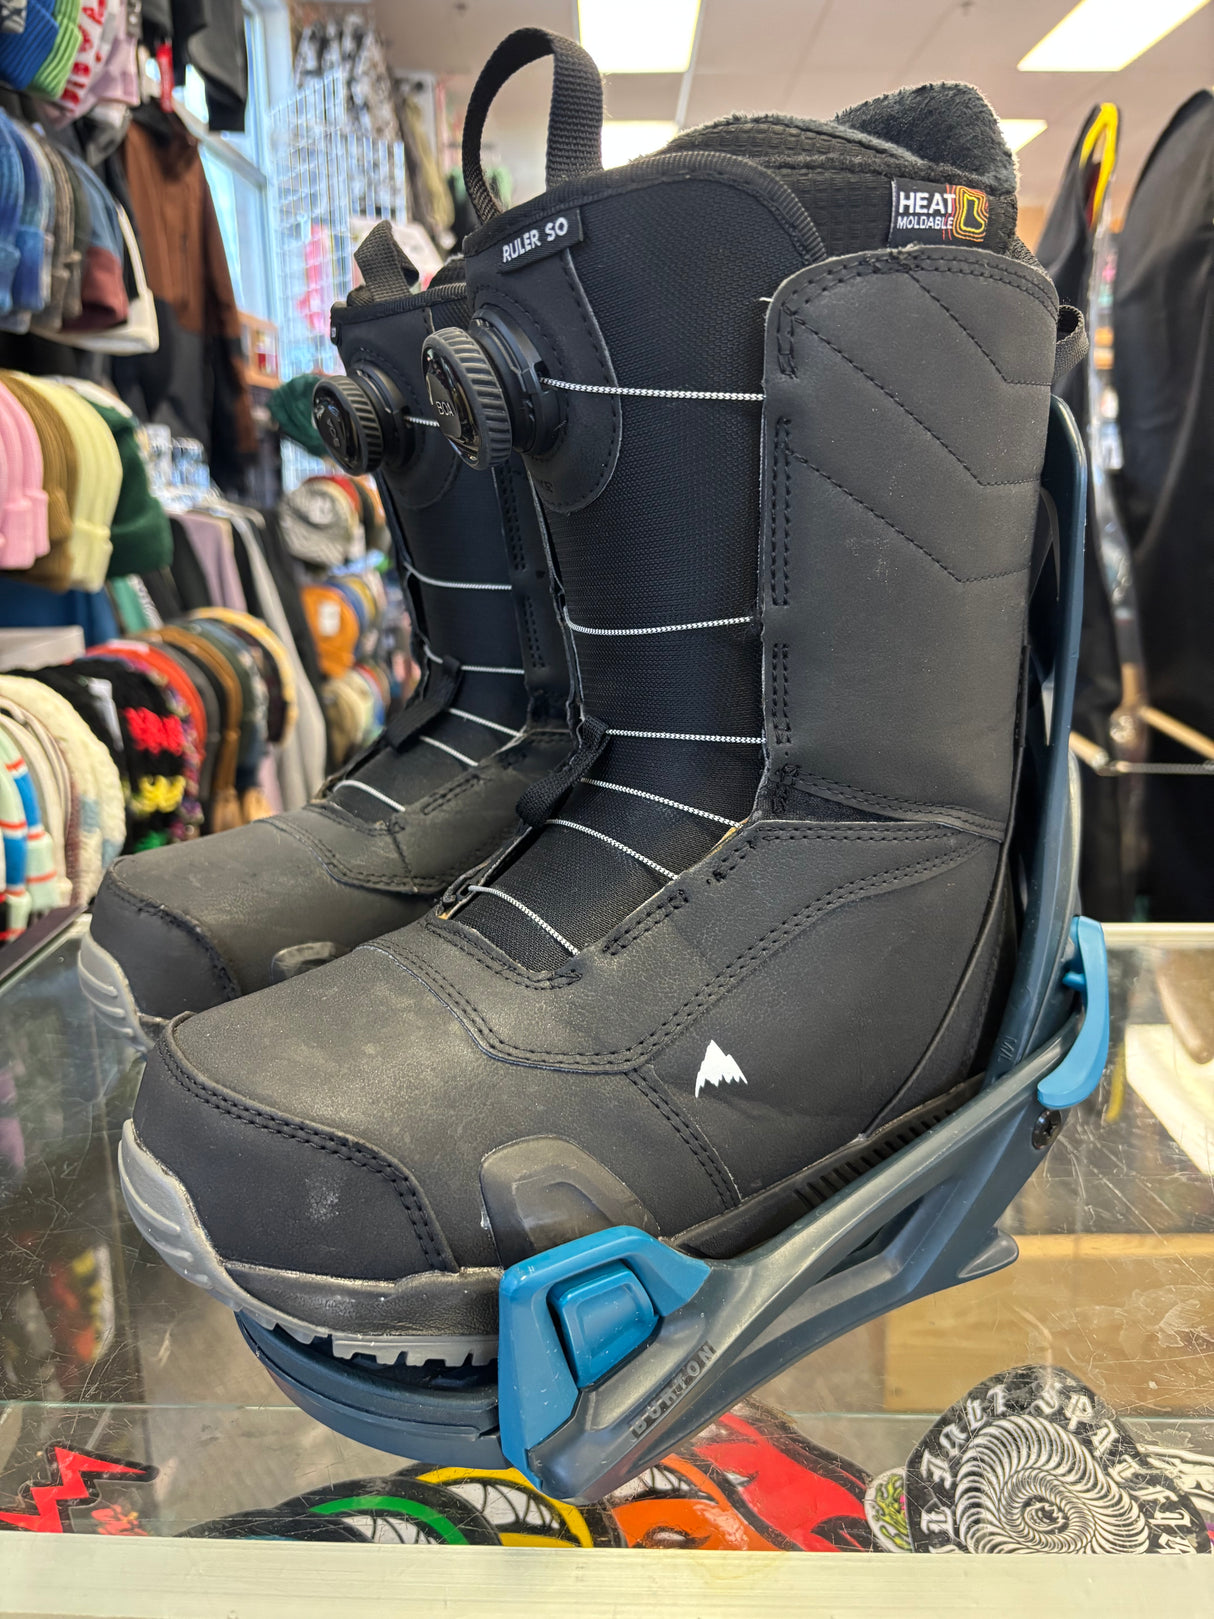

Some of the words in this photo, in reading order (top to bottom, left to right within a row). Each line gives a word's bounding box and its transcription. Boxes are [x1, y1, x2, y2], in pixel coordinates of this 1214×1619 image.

[898, 191, 956, 214] HEAT
[896, 215, 954, 230] MOLDABLE
[502, 229, 542, 263] RULER
[545, 216, 569, 242] SO
[435, 401, 455, 417] BOA
[628, 1341, 716, 1436] BURTON
